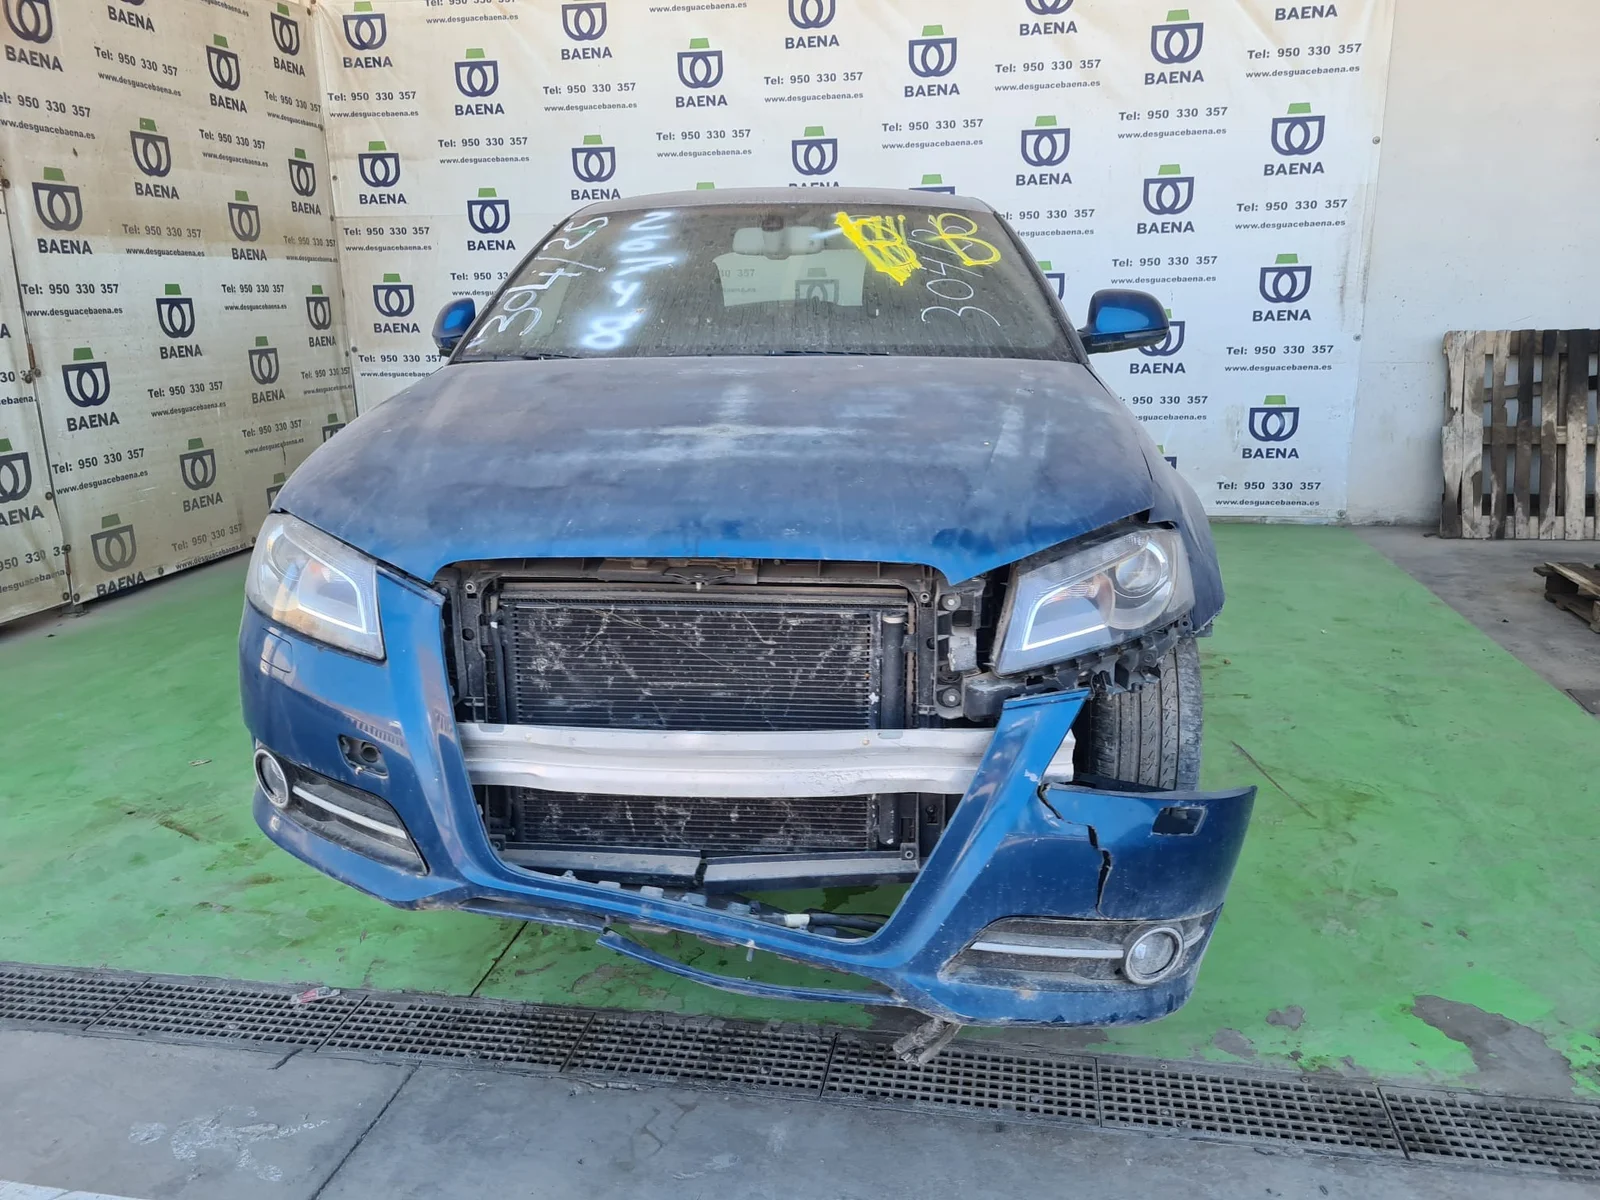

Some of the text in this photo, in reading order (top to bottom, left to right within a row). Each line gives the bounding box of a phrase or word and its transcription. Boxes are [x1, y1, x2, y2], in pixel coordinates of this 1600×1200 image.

[649, 2, 747, 13] www.desguacebaena.es
[1275, 4, 1338, 21] BAENA
[107, 5, 155, 32] BAENA
[426, 14, 518, 24] www.desguacebaena.es
[1020, 21, 1078, 36] BAENA
[785, 34, 840, 49] BAENA
[561, 46, 612, 60] BAENA
[1247, 43, 1362, 59] Tel: 950 330 357
[4, 44, 64, 72] BAENA
[94, 46, 178, 76] Tel: 950 330 357
[343, 56, 393, 69] BAENA
[273, 56, 306, 77] BAENA
[995, 59, 1101, 73] Tel: 950 330 357
[1246, 66, 1360, 78] www.desguacebaena.es
[764, 71, 863, 85] Tel: 950 330 357
[1144, 70, 1204, 85] BAENA
[542, 82, 636, 95] Tel: 950 330 357
[904, 83, 960, 98] BAENA
[994, 81, 1100, 91] www.desguacebaena.es
[327, 91, 416, 101] Tel: 950 330 357
[676, 94, 728, 108] BAENA
[764, 93, 864, 103] www.desguacebaena.es
[17, 94, 40, 109] 950
[45, 100, 66, 114] 330
[72, 104, 90, 118] 357
[209, 93, 248, 114] BAENA
[454, 103, 505, 116] BAENA
[544, 103, 637, 112] www.desguacebaena.es
[329, 110, 419, 119] www.desguacebaena.es
[1118, 106, 1228, 121] Tel: 950 330 357
[882, 118, 984, 132] Tel: 950 330 357
[198, 128, 265, 150] Tel: 950 330 357
[656, 129, 751, 141] Tel: 950 330 357
[1118, 128, 1227, 139] www.desguacebaena.es
[438, 137, 528, 148] Tel: 950 330 357
[882, 140, 983, 150] www.desguacebaena.es
[439, 156, 530, 164] www.desguacebaena.es
[656, 149, 752, 158] www.desguacebaena.es
[1264, 161, 1324, 176] BAENA
[1016, 172, 1072, 186] BAENA
[134, 182, 180, 200] BAENA
[571, 188, 621, 200] BAENA
[359, 193, 407, 204] BAENA
[1236, 198, 1348, 212] Tel: 950 330 357
[291, 200, 322, 216] BAENA
[1019, 208, 1095, 220] 950 330 357
[343, 226, 430, 236] Tel: 950 330 357
[1137, 221, 1195, 234] BAENA
[1235, 220, 1346, 230] www.desguacebaena.es
[37, 238, 93, 255] BAENA
[345, 244, 432, 252] www.desguacebaena.es
[467, 239, 516, 251] BAENA
[231, 248, 267, 261] BAENA
[1112, 256, 1218, 267] Tel: 950 330 357
[1110, 276, 1216, 285] www.desguacebaena.es
[20, 283, 119, 295] Tel: 950 330 357
[221, 284, 284, 293] Tel: 950 330 357
[1252, 309, 1311, 322] BAENA
[374, 322, 420, 333] BAENA
[308, 336, 337, 348] BAENA
[159, 344, 203, 360] BAENA
[1226, 345, 1334, 355] Tel: 950 330 357
[358, 354, 441, 363] Tel: 950 330 357
[1130, 362, 1186, 374] BAENA
[1224, 364, 1332, 372] www.desguacebaena.es
[147, 381, 223, 398] Tel: 950 330 357
[252, 388, 286, 404] BAENA
[1132, 396, 1153, 404] 950
[1160, 396, 1180, 404] 330
[1187, 396, 1208, 404] 357
[66, 411, 120, 432] BAENA
[1242, 448, 1299, 459] BAENA
[52, 448, 144, 474] Tel: 950 330 357
[1216, 482, 1321, 490] Tel: 950 330 357
[182, 492, 223, 513] BAENA
